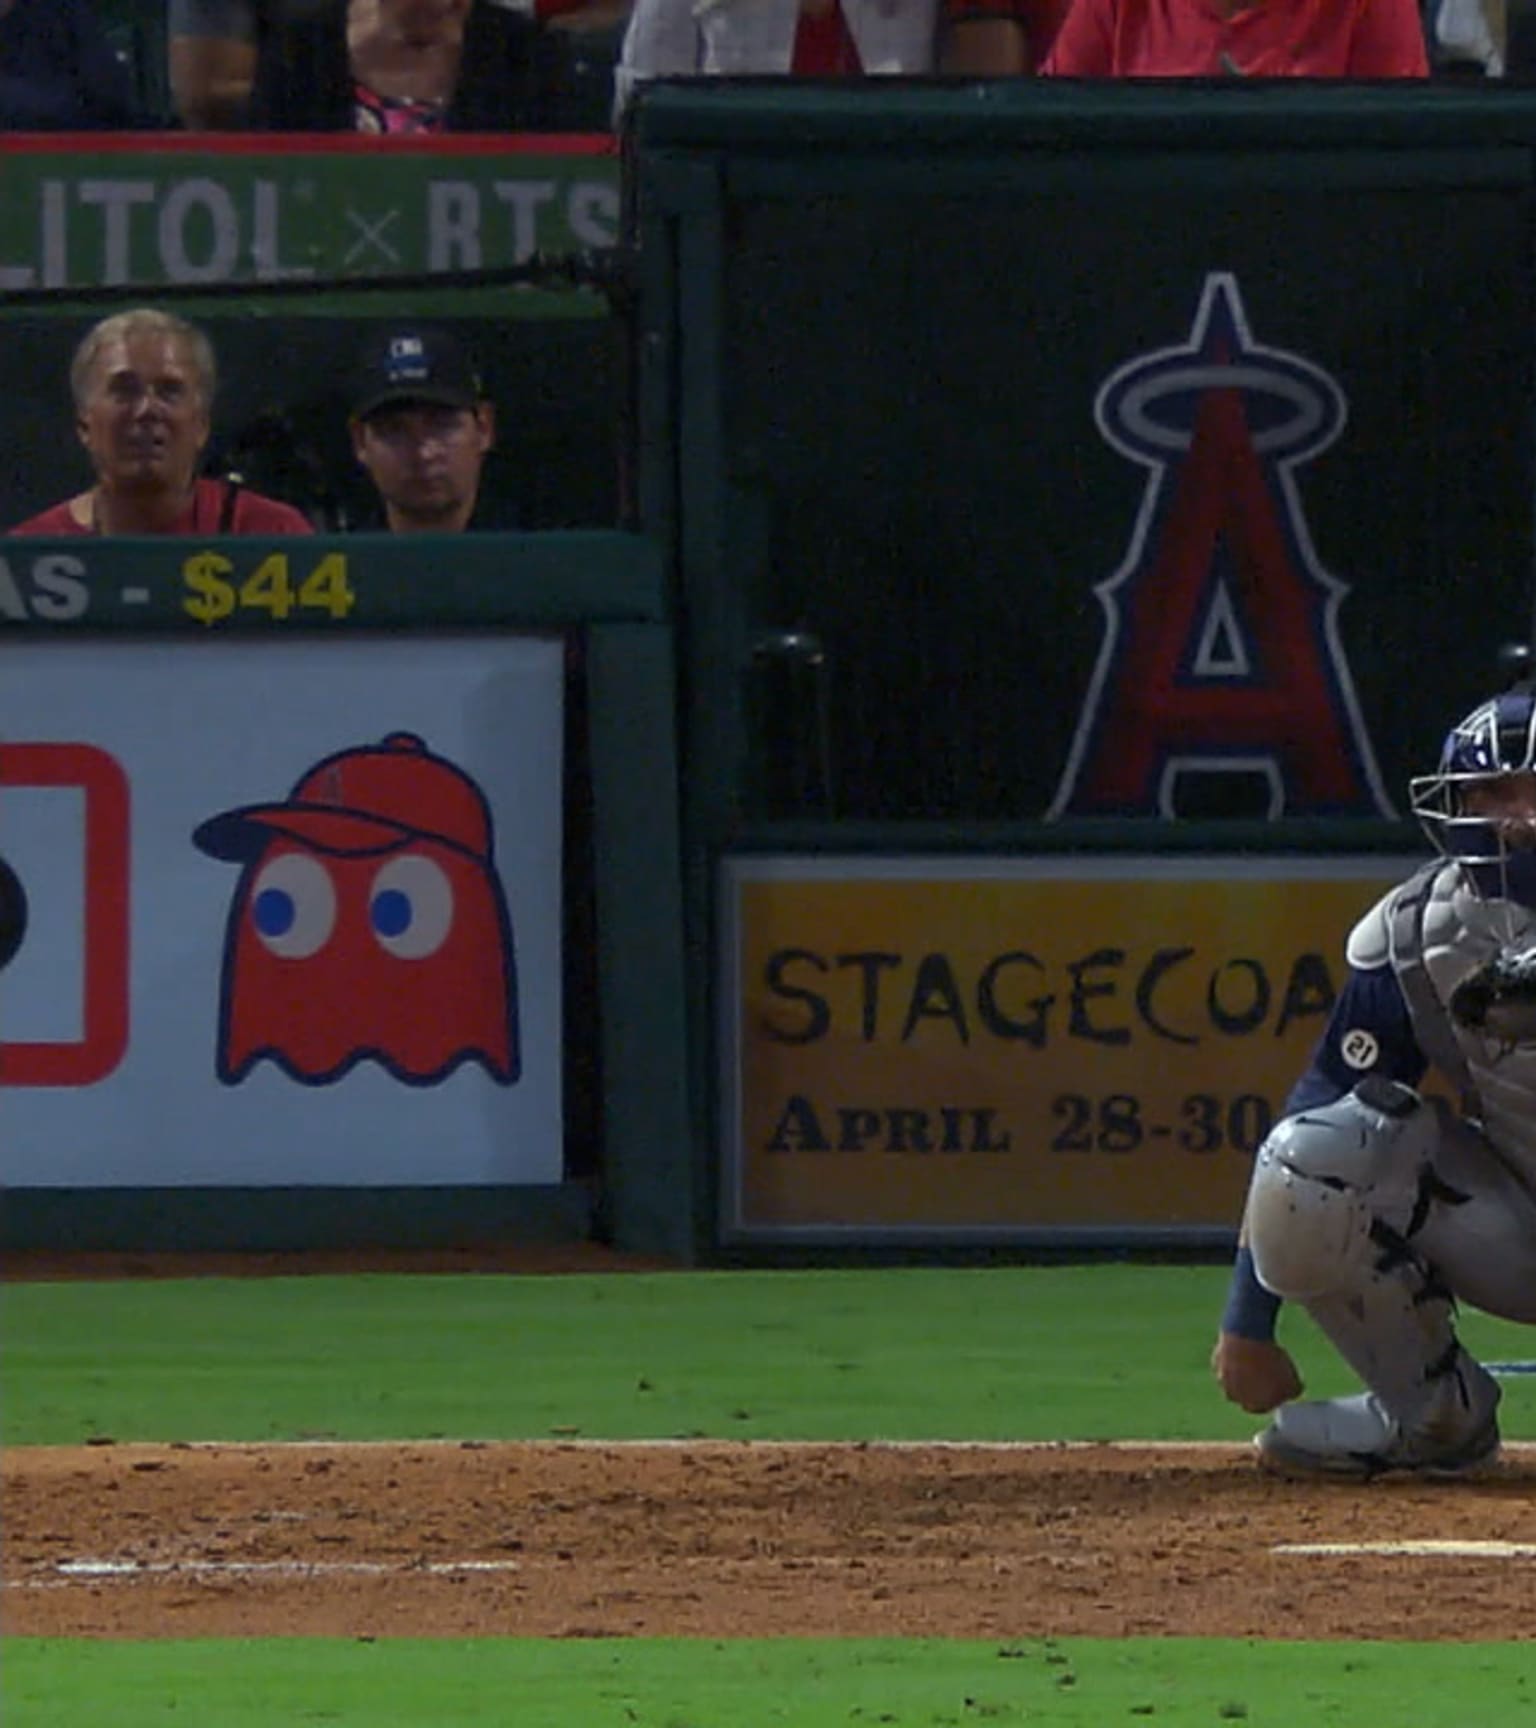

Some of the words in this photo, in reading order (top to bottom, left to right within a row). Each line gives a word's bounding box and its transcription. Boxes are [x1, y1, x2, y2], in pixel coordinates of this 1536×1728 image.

[181, 551, 356, 625] $44
[763, 946, 1336, 1047] STAGECOA
[1346, 1035, 1374, 1064] 21
[1051, 1094, 1274, 1153] 28-30
